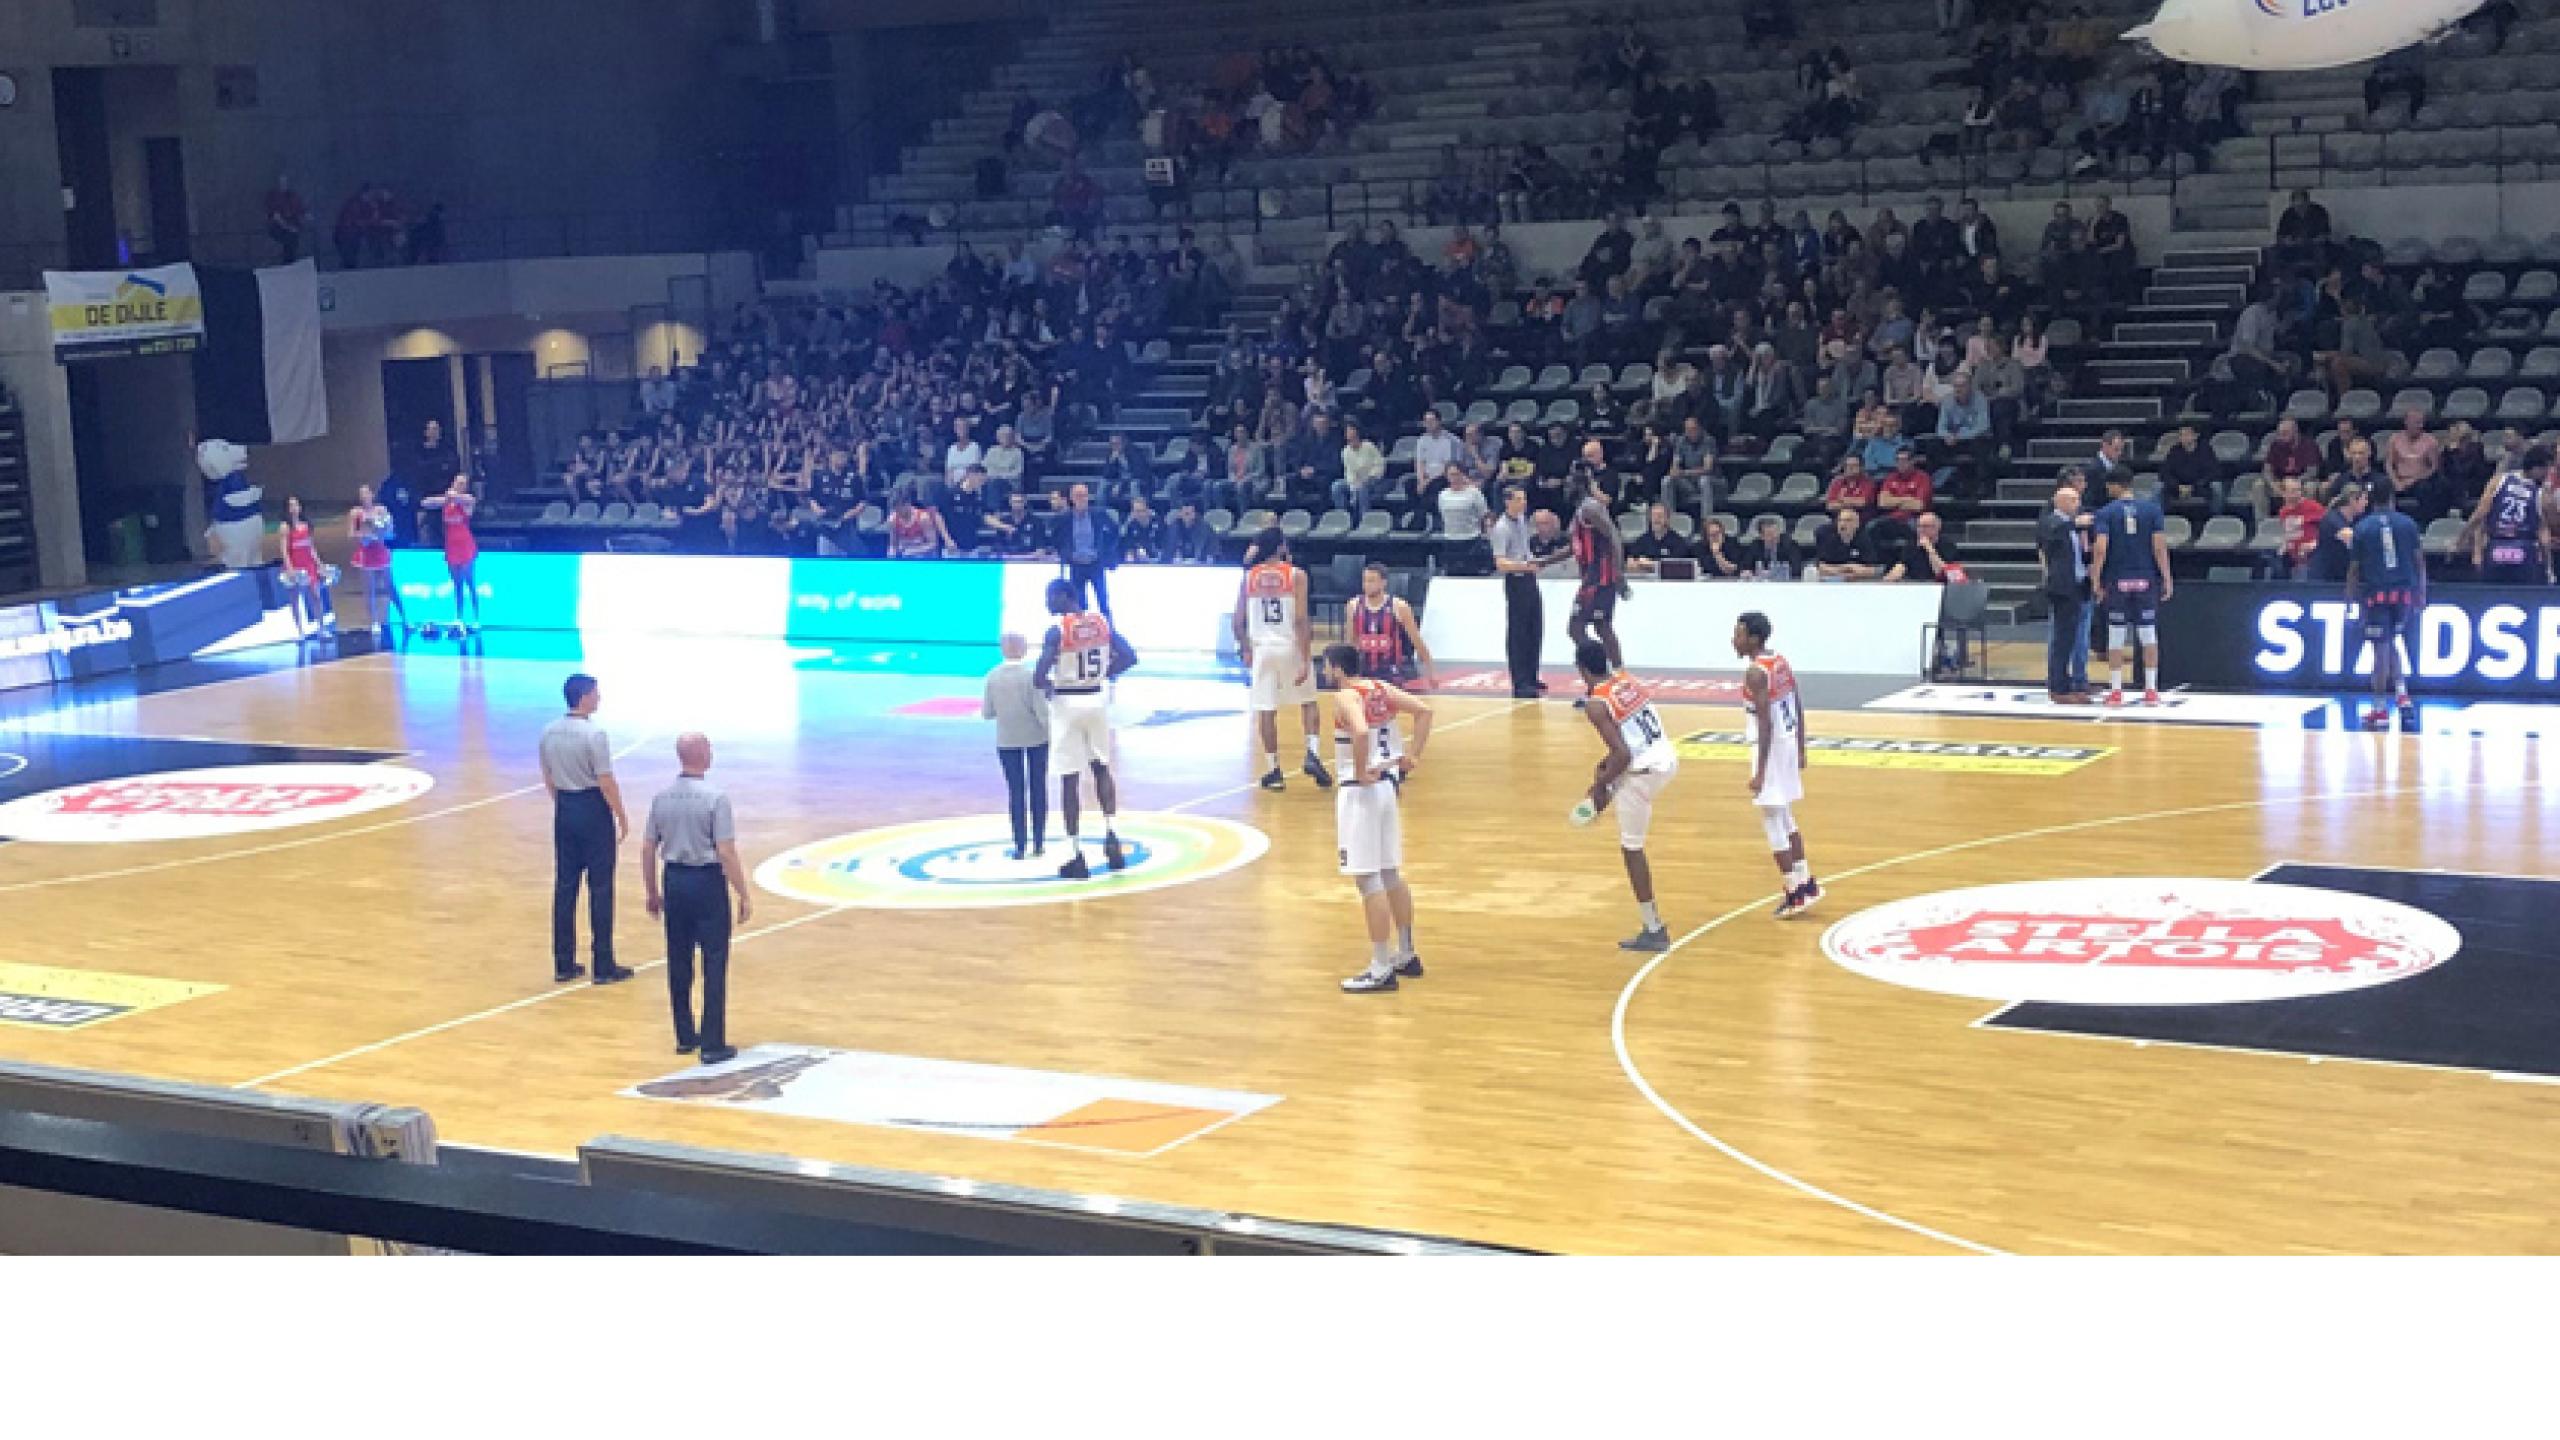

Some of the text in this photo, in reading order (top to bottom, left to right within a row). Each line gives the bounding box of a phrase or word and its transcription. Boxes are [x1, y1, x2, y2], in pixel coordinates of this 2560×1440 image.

[85, 304, 111, 327] DE
[1260, 598, 1284, 623] 13
[1077, 648, 1102, 682] 15
[1966, 918, 2331, 946] STELLA
[1943, 937, 2328, 965] ARTOIS
